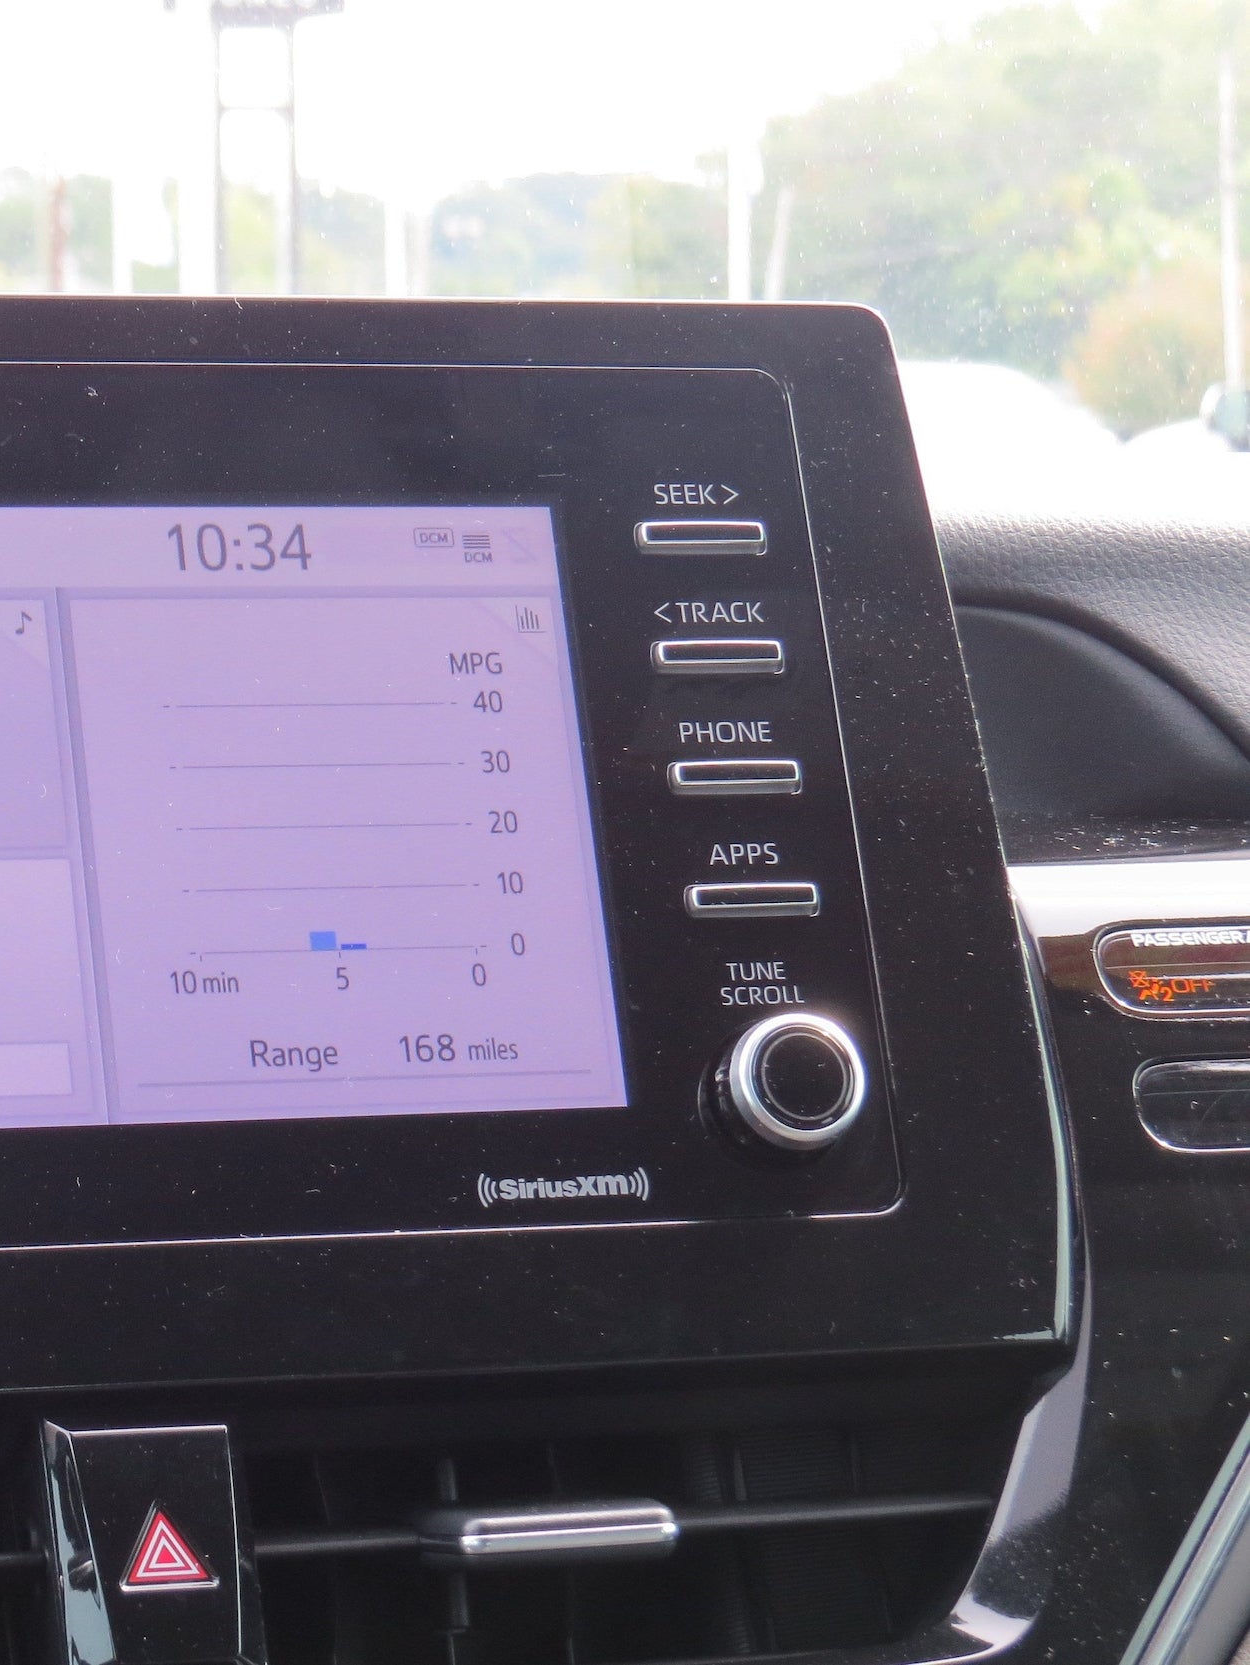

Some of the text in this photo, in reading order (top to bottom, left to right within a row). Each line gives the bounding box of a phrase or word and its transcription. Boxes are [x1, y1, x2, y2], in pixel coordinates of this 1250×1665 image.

[654, 484, 717, 505] SEEK
[167, 523, 312, 571] 10:34
[419, 532, 449, 544] DCM
[464, 552, 493, 563] DCM
[675, 602, 764, 623] TRACK
[449, 652, 503, 675] MPG
[473, 691, 503, 713] 40
[679, 721, 773, 743] PHONE
[481, 751, 510, 773] 30
[488, 811, 518, 833] 20
[709, 843, 779, 865] APPS
[498, 871, 523, 894] 10
[510, 933, 526, 956] 0
[1131, 930, 1245, 947] PASSENGER
[169, 971, 240, 994] 10 min
[336, 967, 350, 990] 5
[471, 963, 488, 986] 0
[726, 962, 786, 981] TUNE
[720, 986, 805, 1006] SCROLL
[250, 1034, 519, 1072] Range 168 miles
